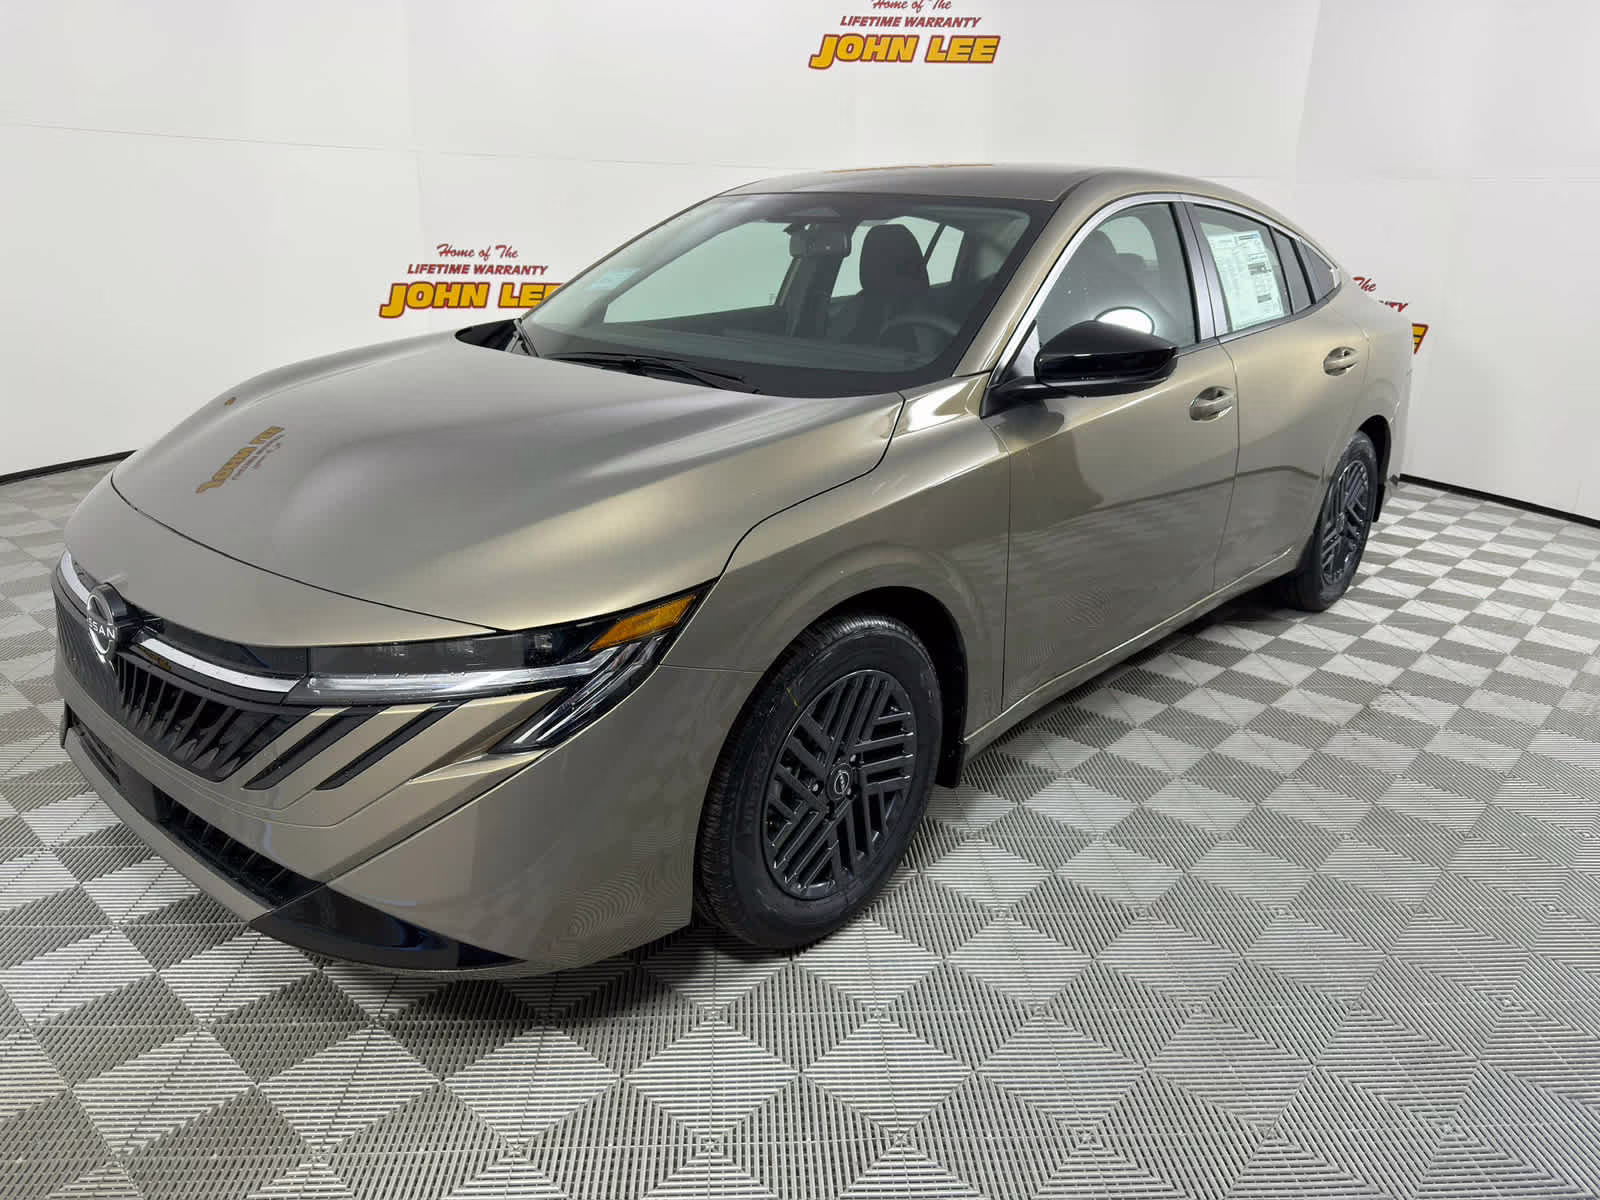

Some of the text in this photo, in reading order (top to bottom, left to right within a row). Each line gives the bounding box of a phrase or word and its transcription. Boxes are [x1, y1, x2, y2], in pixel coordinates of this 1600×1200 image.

[871, 0, 908, 10] Home
[911, 0, 922, 13] of
[840, 16, 981, 28] LIFETIME WARRANTY
[808, 33, 1001, 69] JOHN LEE
[436, 243, 519, 261] Home of The
[407, 264, 548, 275] LIFETIME WARRANTY
[1352, 276, 1376, 292] The
[379, 281, 490, 318] JOHN
